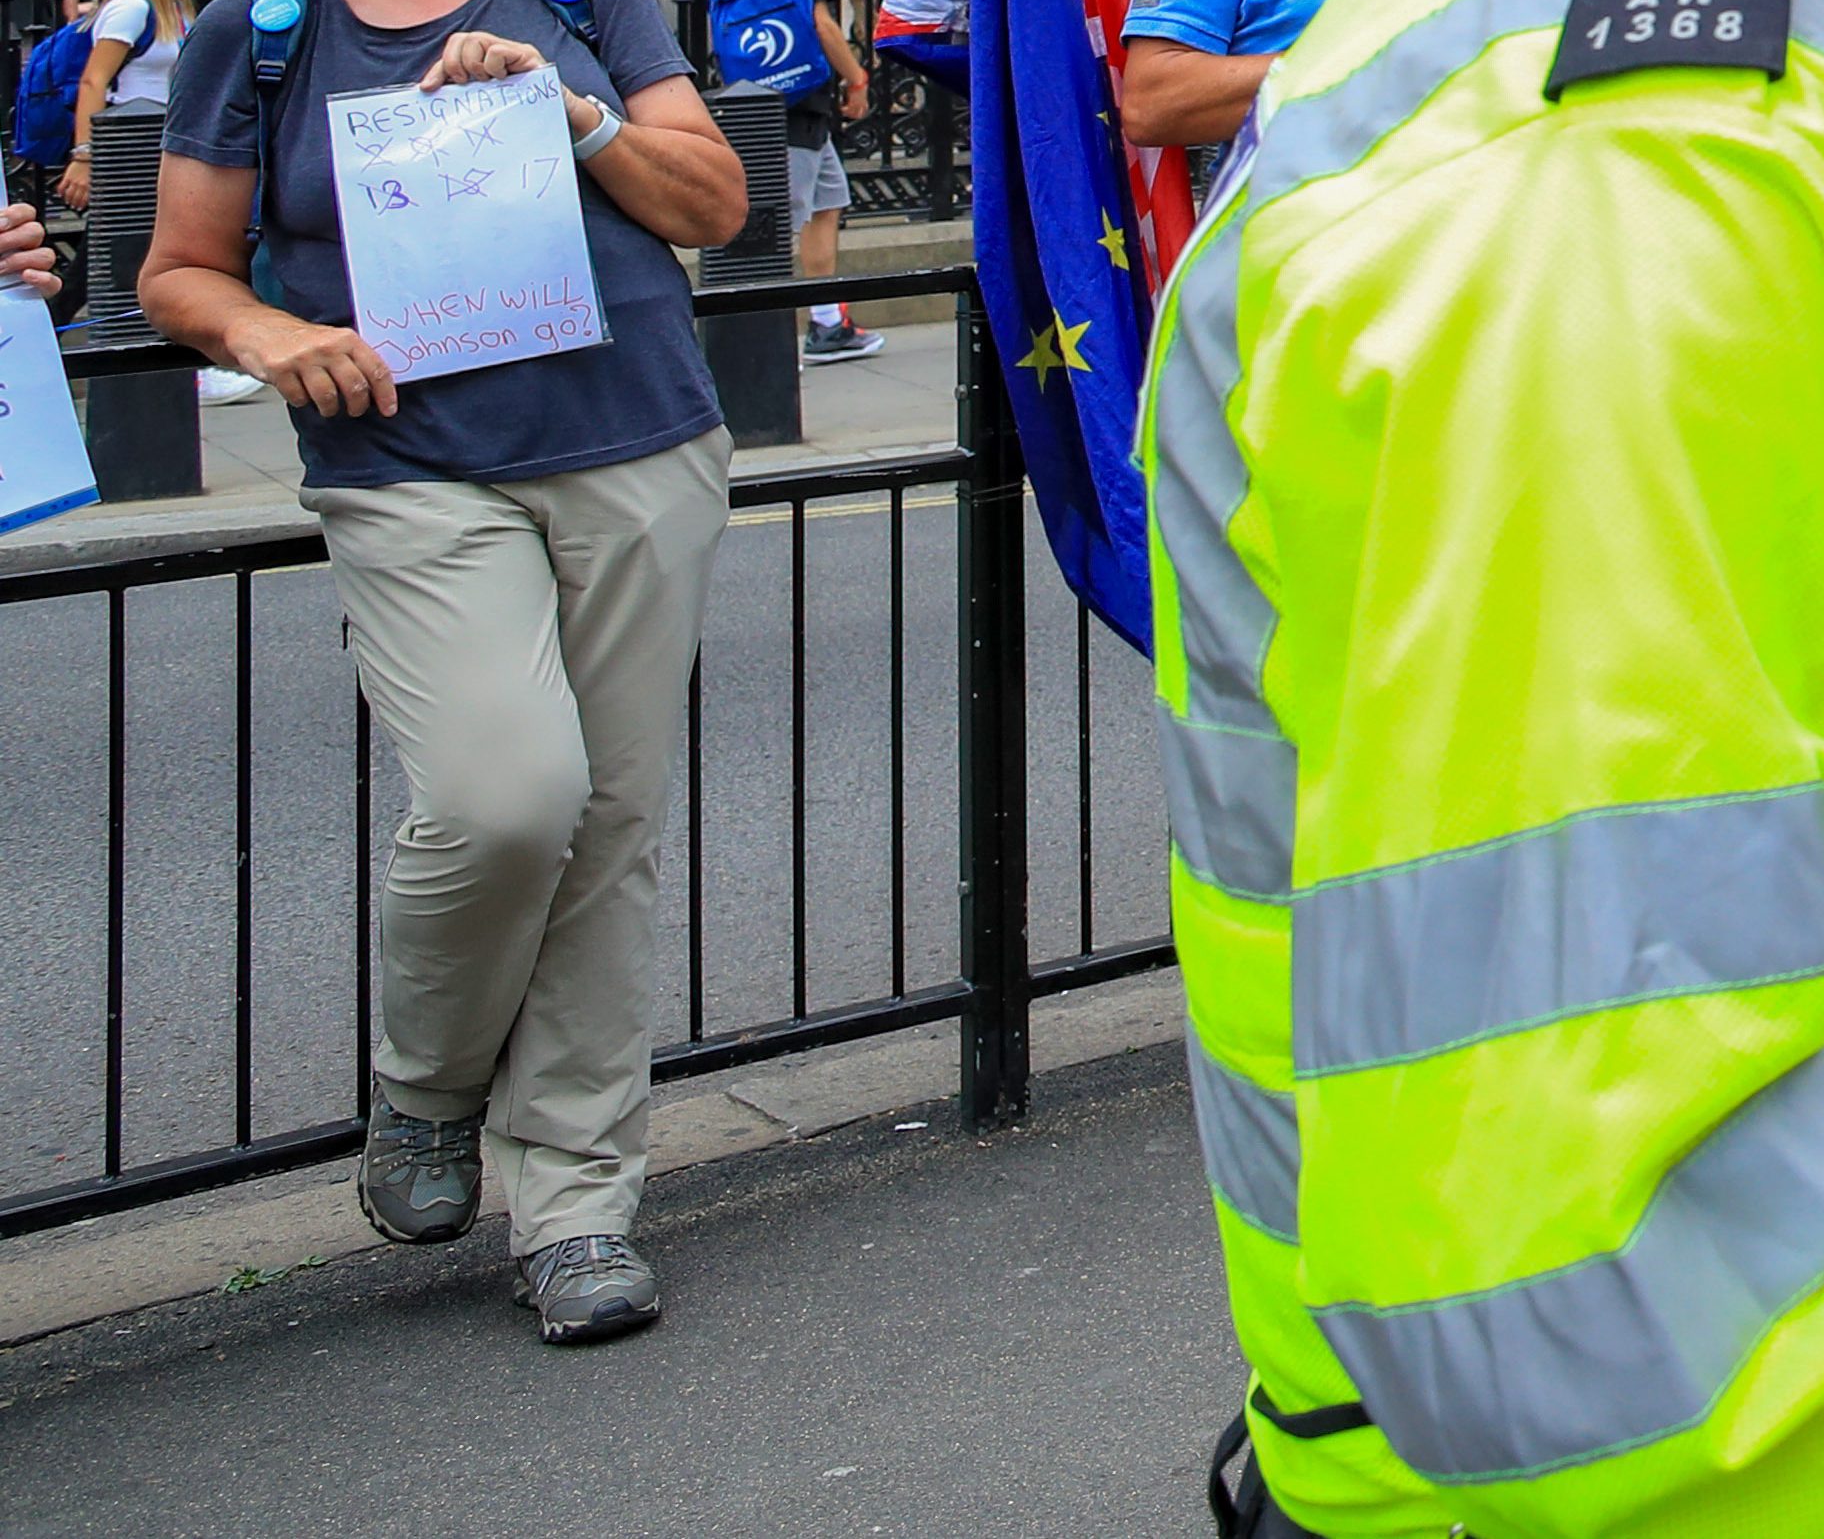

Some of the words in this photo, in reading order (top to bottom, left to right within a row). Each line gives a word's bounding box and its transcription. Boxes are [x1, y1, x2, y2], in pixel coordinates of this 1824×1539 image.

[1586, 10, 1744, 50] 1368
[521, 157, 561, 199] 17
[366, 287, 486, 330] WHEN
[373, 327, 518, 375] Johnson
[533, 304, 594, 352] go?
